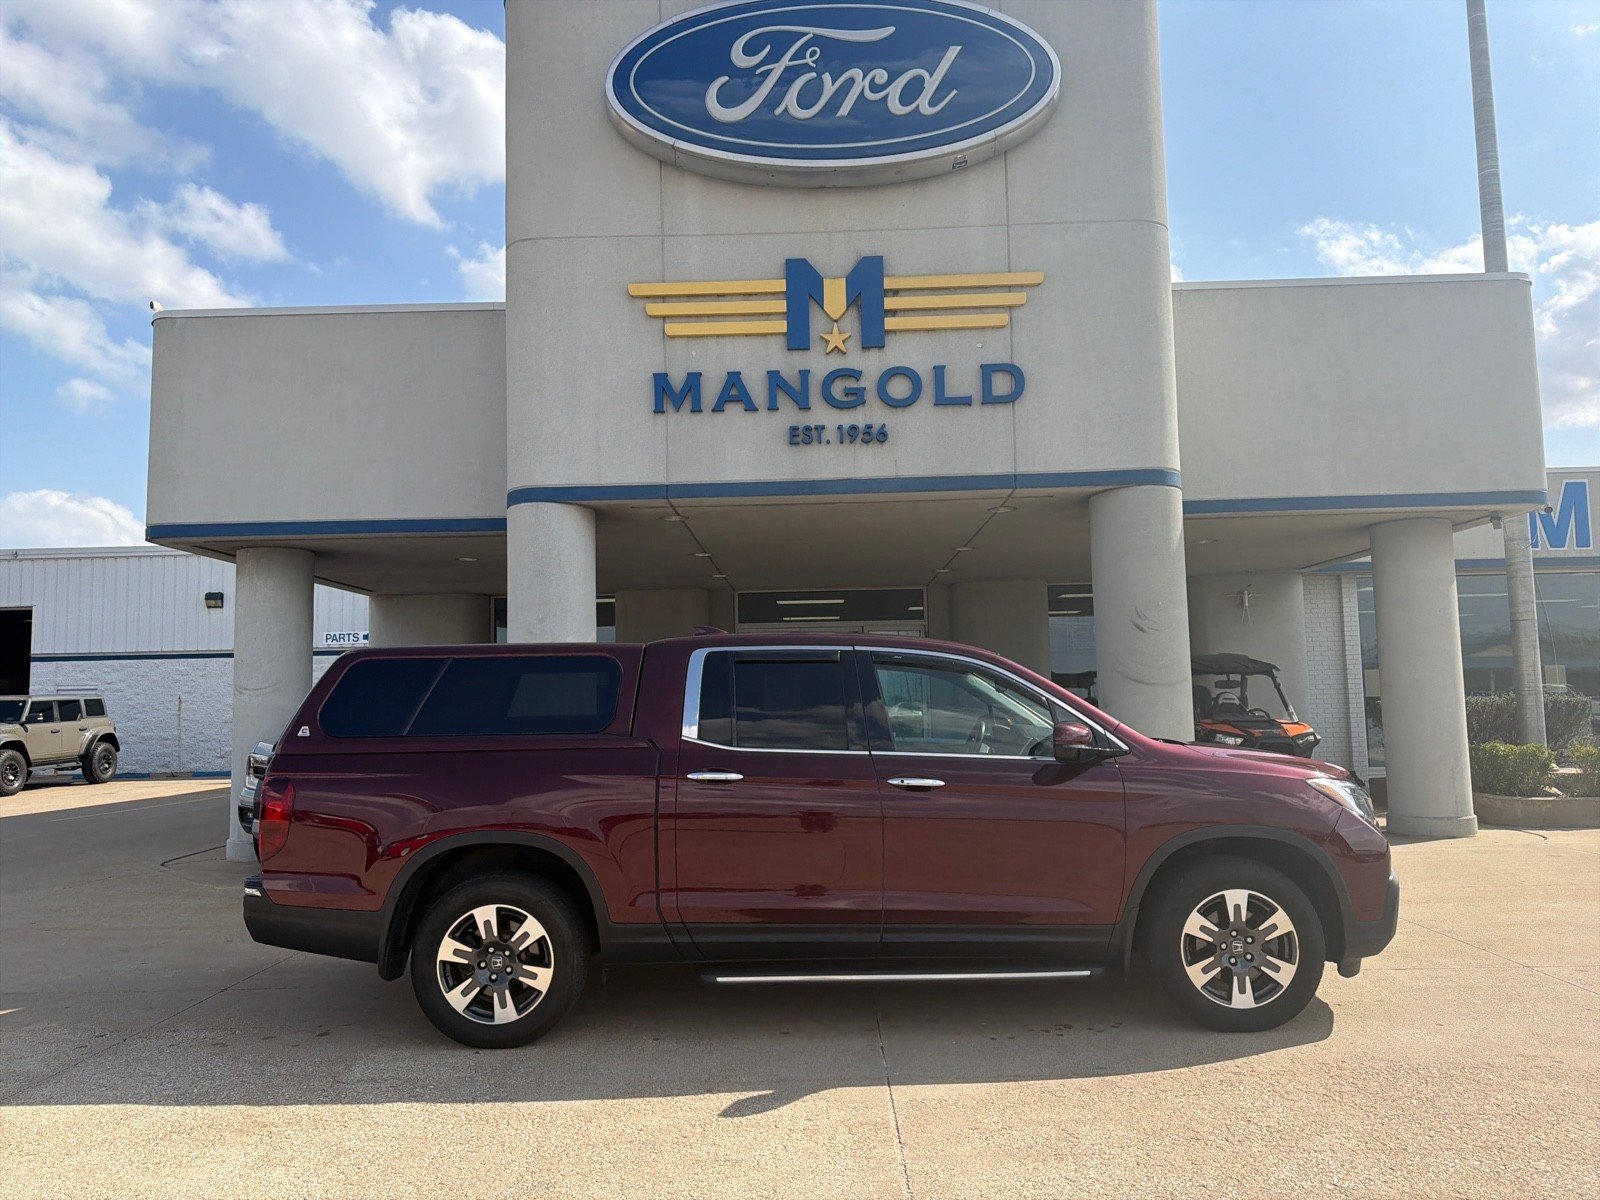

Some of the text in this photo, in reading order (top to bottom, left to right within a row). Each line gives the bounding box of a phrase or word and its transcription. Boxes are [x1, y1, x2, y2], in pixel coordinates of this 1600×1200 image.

[706, 26, 963, 123] Ford
[652, 363, 1027, 414] MANGOLD
[789, 423, 889, 446] EST. 1956
[325, 632, 360, 643] PARTS
